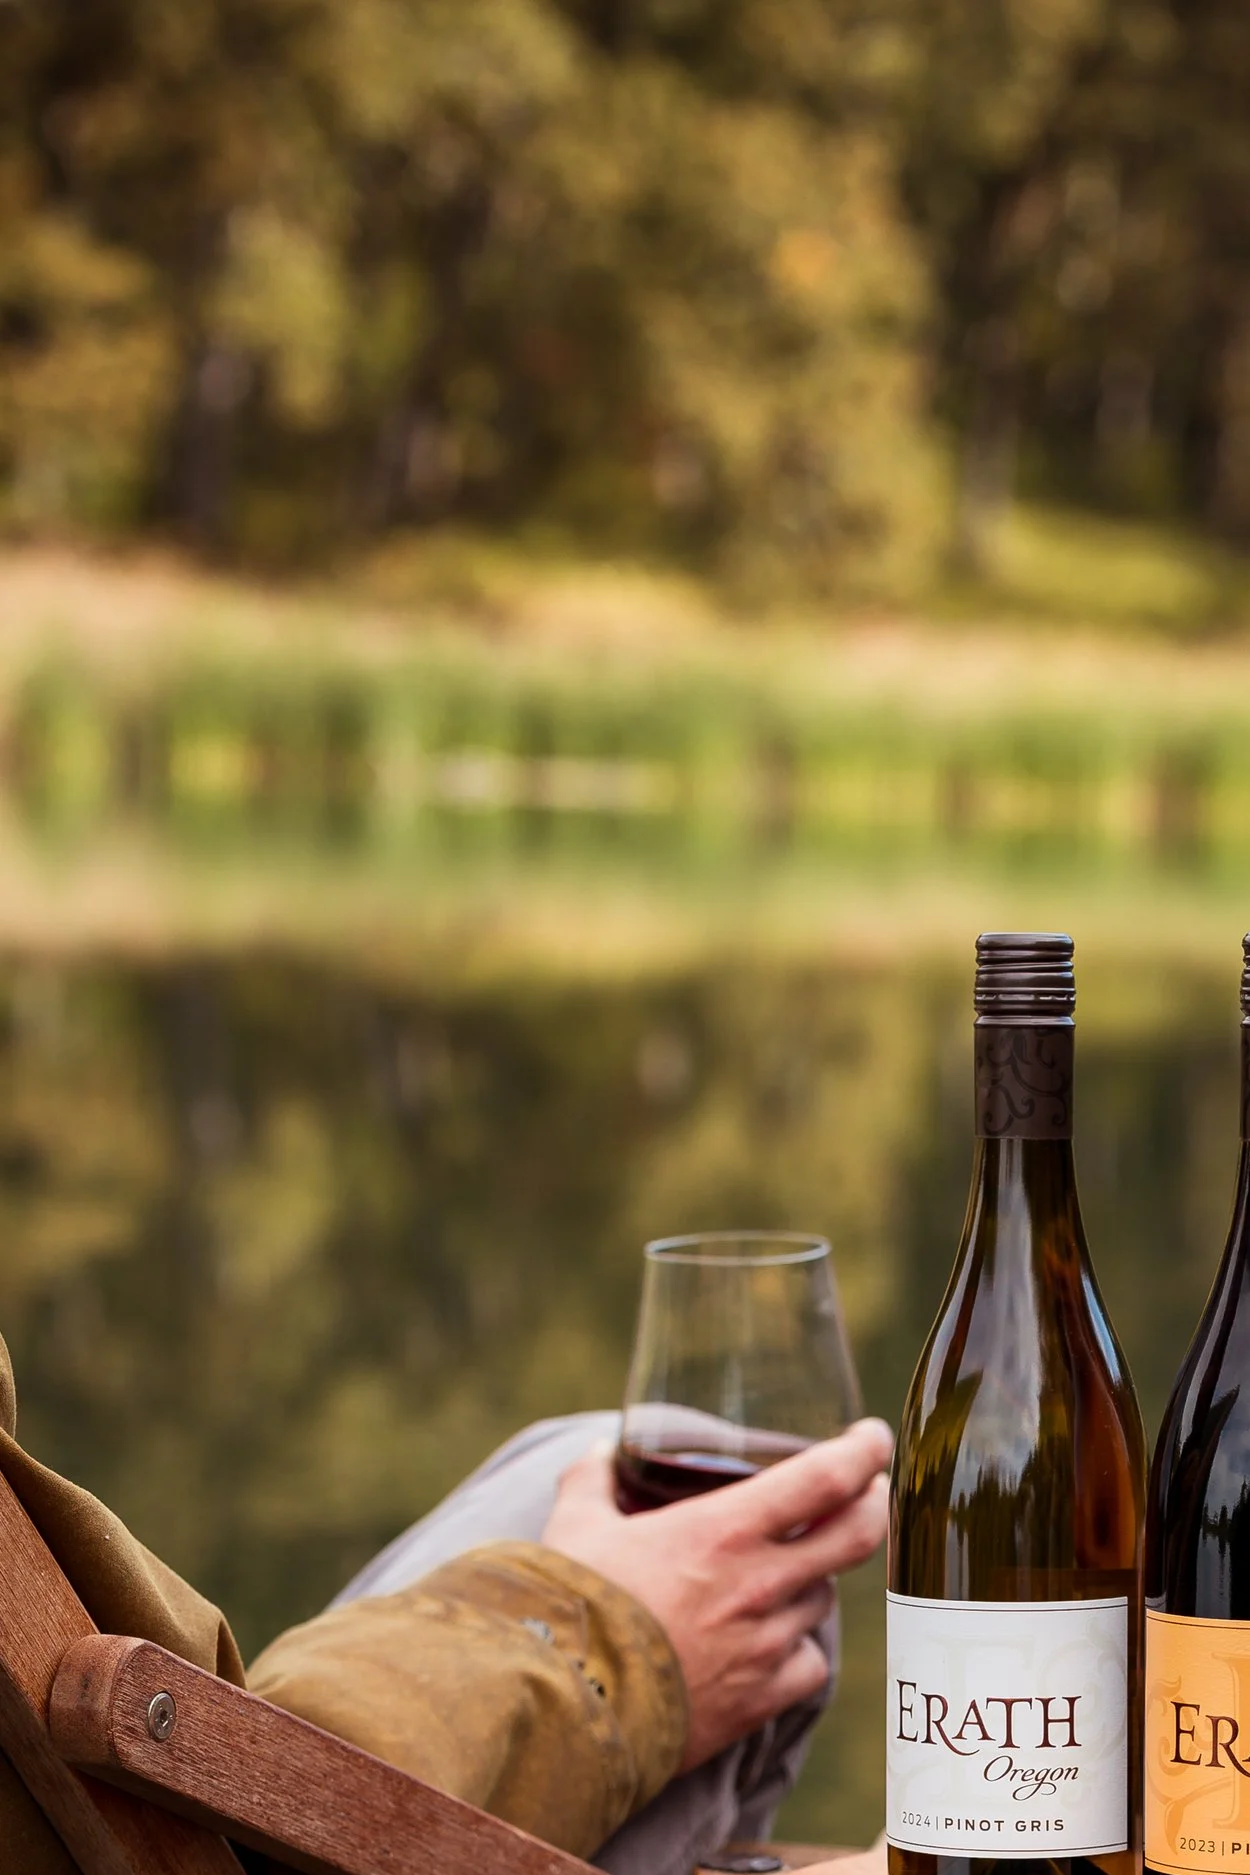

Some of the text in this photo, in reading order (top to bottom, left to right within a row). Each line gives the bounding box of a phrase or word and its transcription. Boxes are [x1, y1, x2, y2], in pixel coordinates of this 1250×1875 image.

[896, 1678, 1083, 1756] ERATH
[983, 1755, 1079, 1801] Oregon
[902, 1811, 1065, 1832] 2024 PINOT GRIS
[1179, 1837, 1216, 1853] 2023
